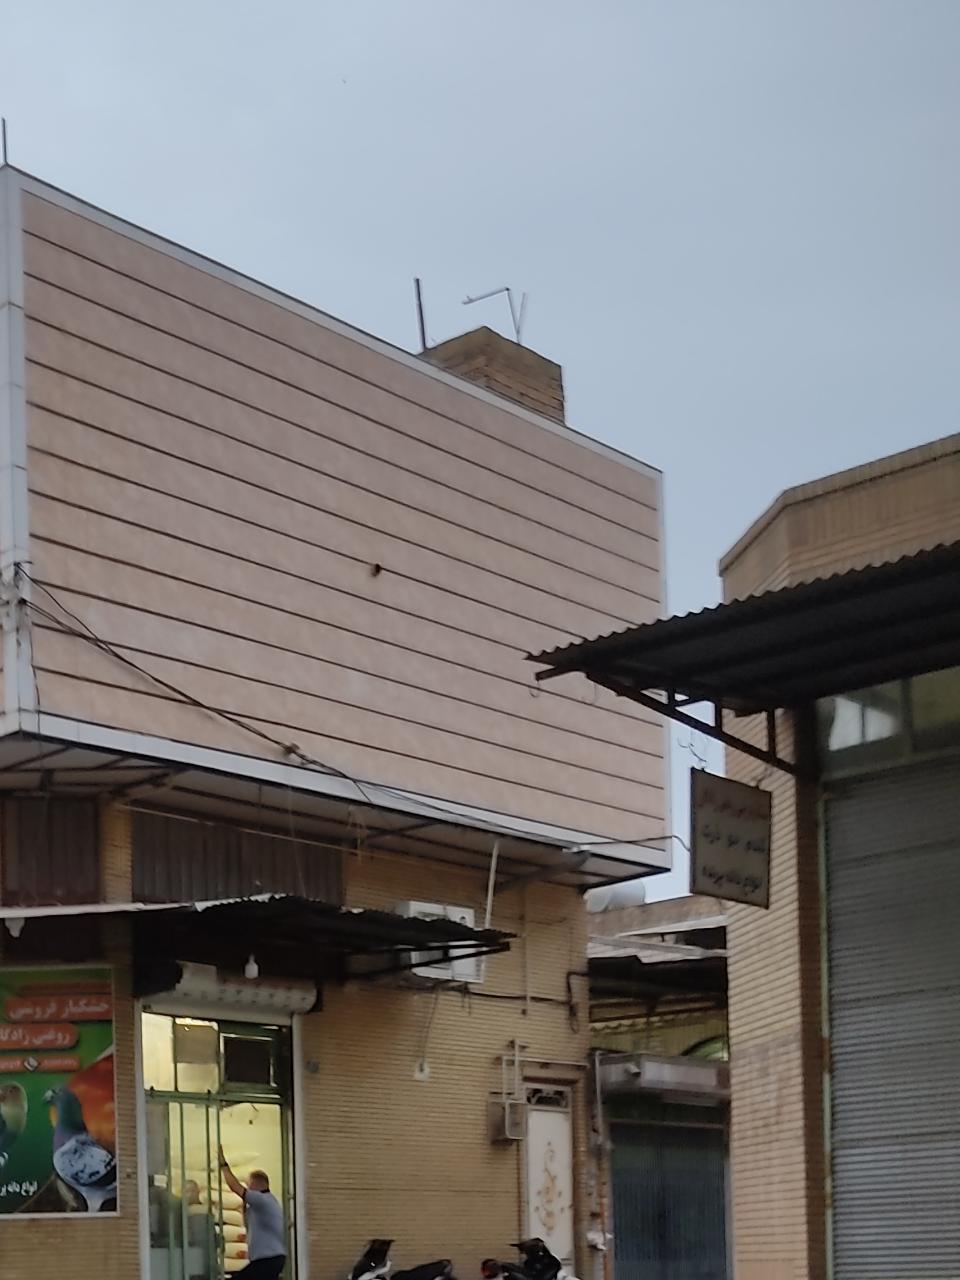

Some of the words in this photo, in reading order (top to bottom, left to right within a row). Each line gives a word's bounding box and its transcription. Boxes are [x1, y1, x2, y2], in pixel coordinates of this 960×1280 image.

[9, 1000, 58, 1019] فروشی
[61, 998, 109, 1019] خشکبار
[7, 1180, 21, 1193] دانه
[20, 1180, 38, 1197] انواع
